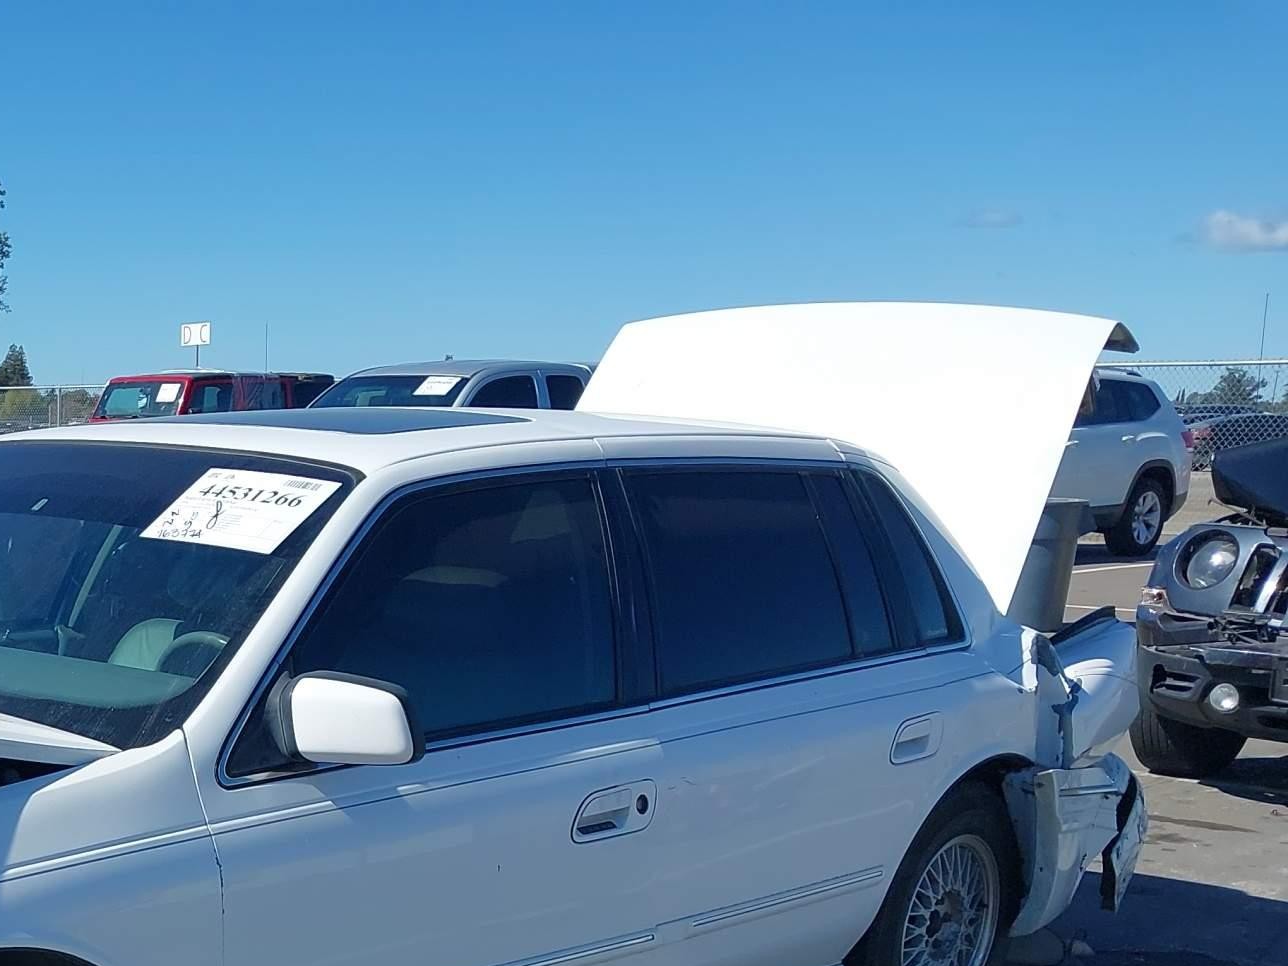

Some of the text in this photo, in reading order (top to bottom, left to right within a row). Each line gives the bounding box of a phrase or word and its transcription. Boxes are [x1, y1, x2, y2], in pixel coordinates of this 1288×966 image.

[183, 323, 208, 344] D C
[199, 484, 305, 508] 44531266
